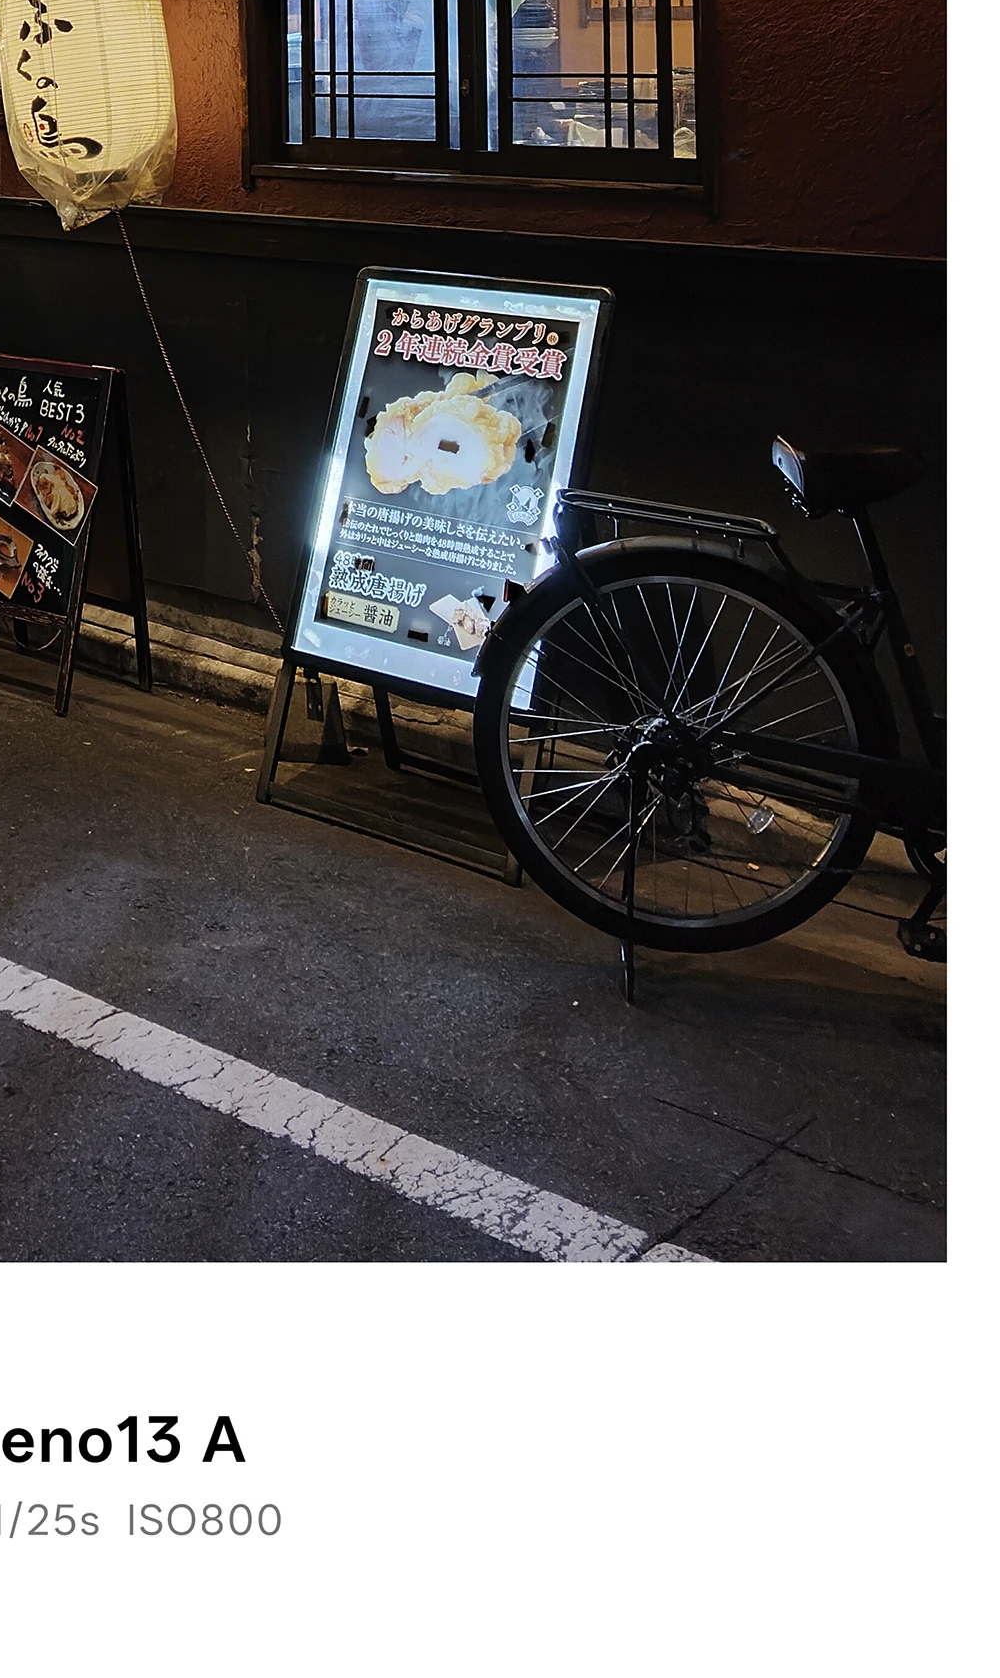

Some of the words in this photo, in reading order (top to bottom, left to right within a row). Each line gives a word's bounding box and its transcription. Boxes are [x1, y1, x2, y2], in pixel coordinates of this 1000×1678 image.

[374, 328, 567, 381] 2年連続金賞受賞
[43, 380, 65, 398] 人気
[346, 501, 526, 551] 本当の唐揚げの美味しさを伝えたい。
[329, 565, 427, 607] 熟成唐揚げ
[329, 604, 360, 618] ジューシー
[364, 604, 394, 627] 醤油
[330, 597, 355, 609] カラッと
